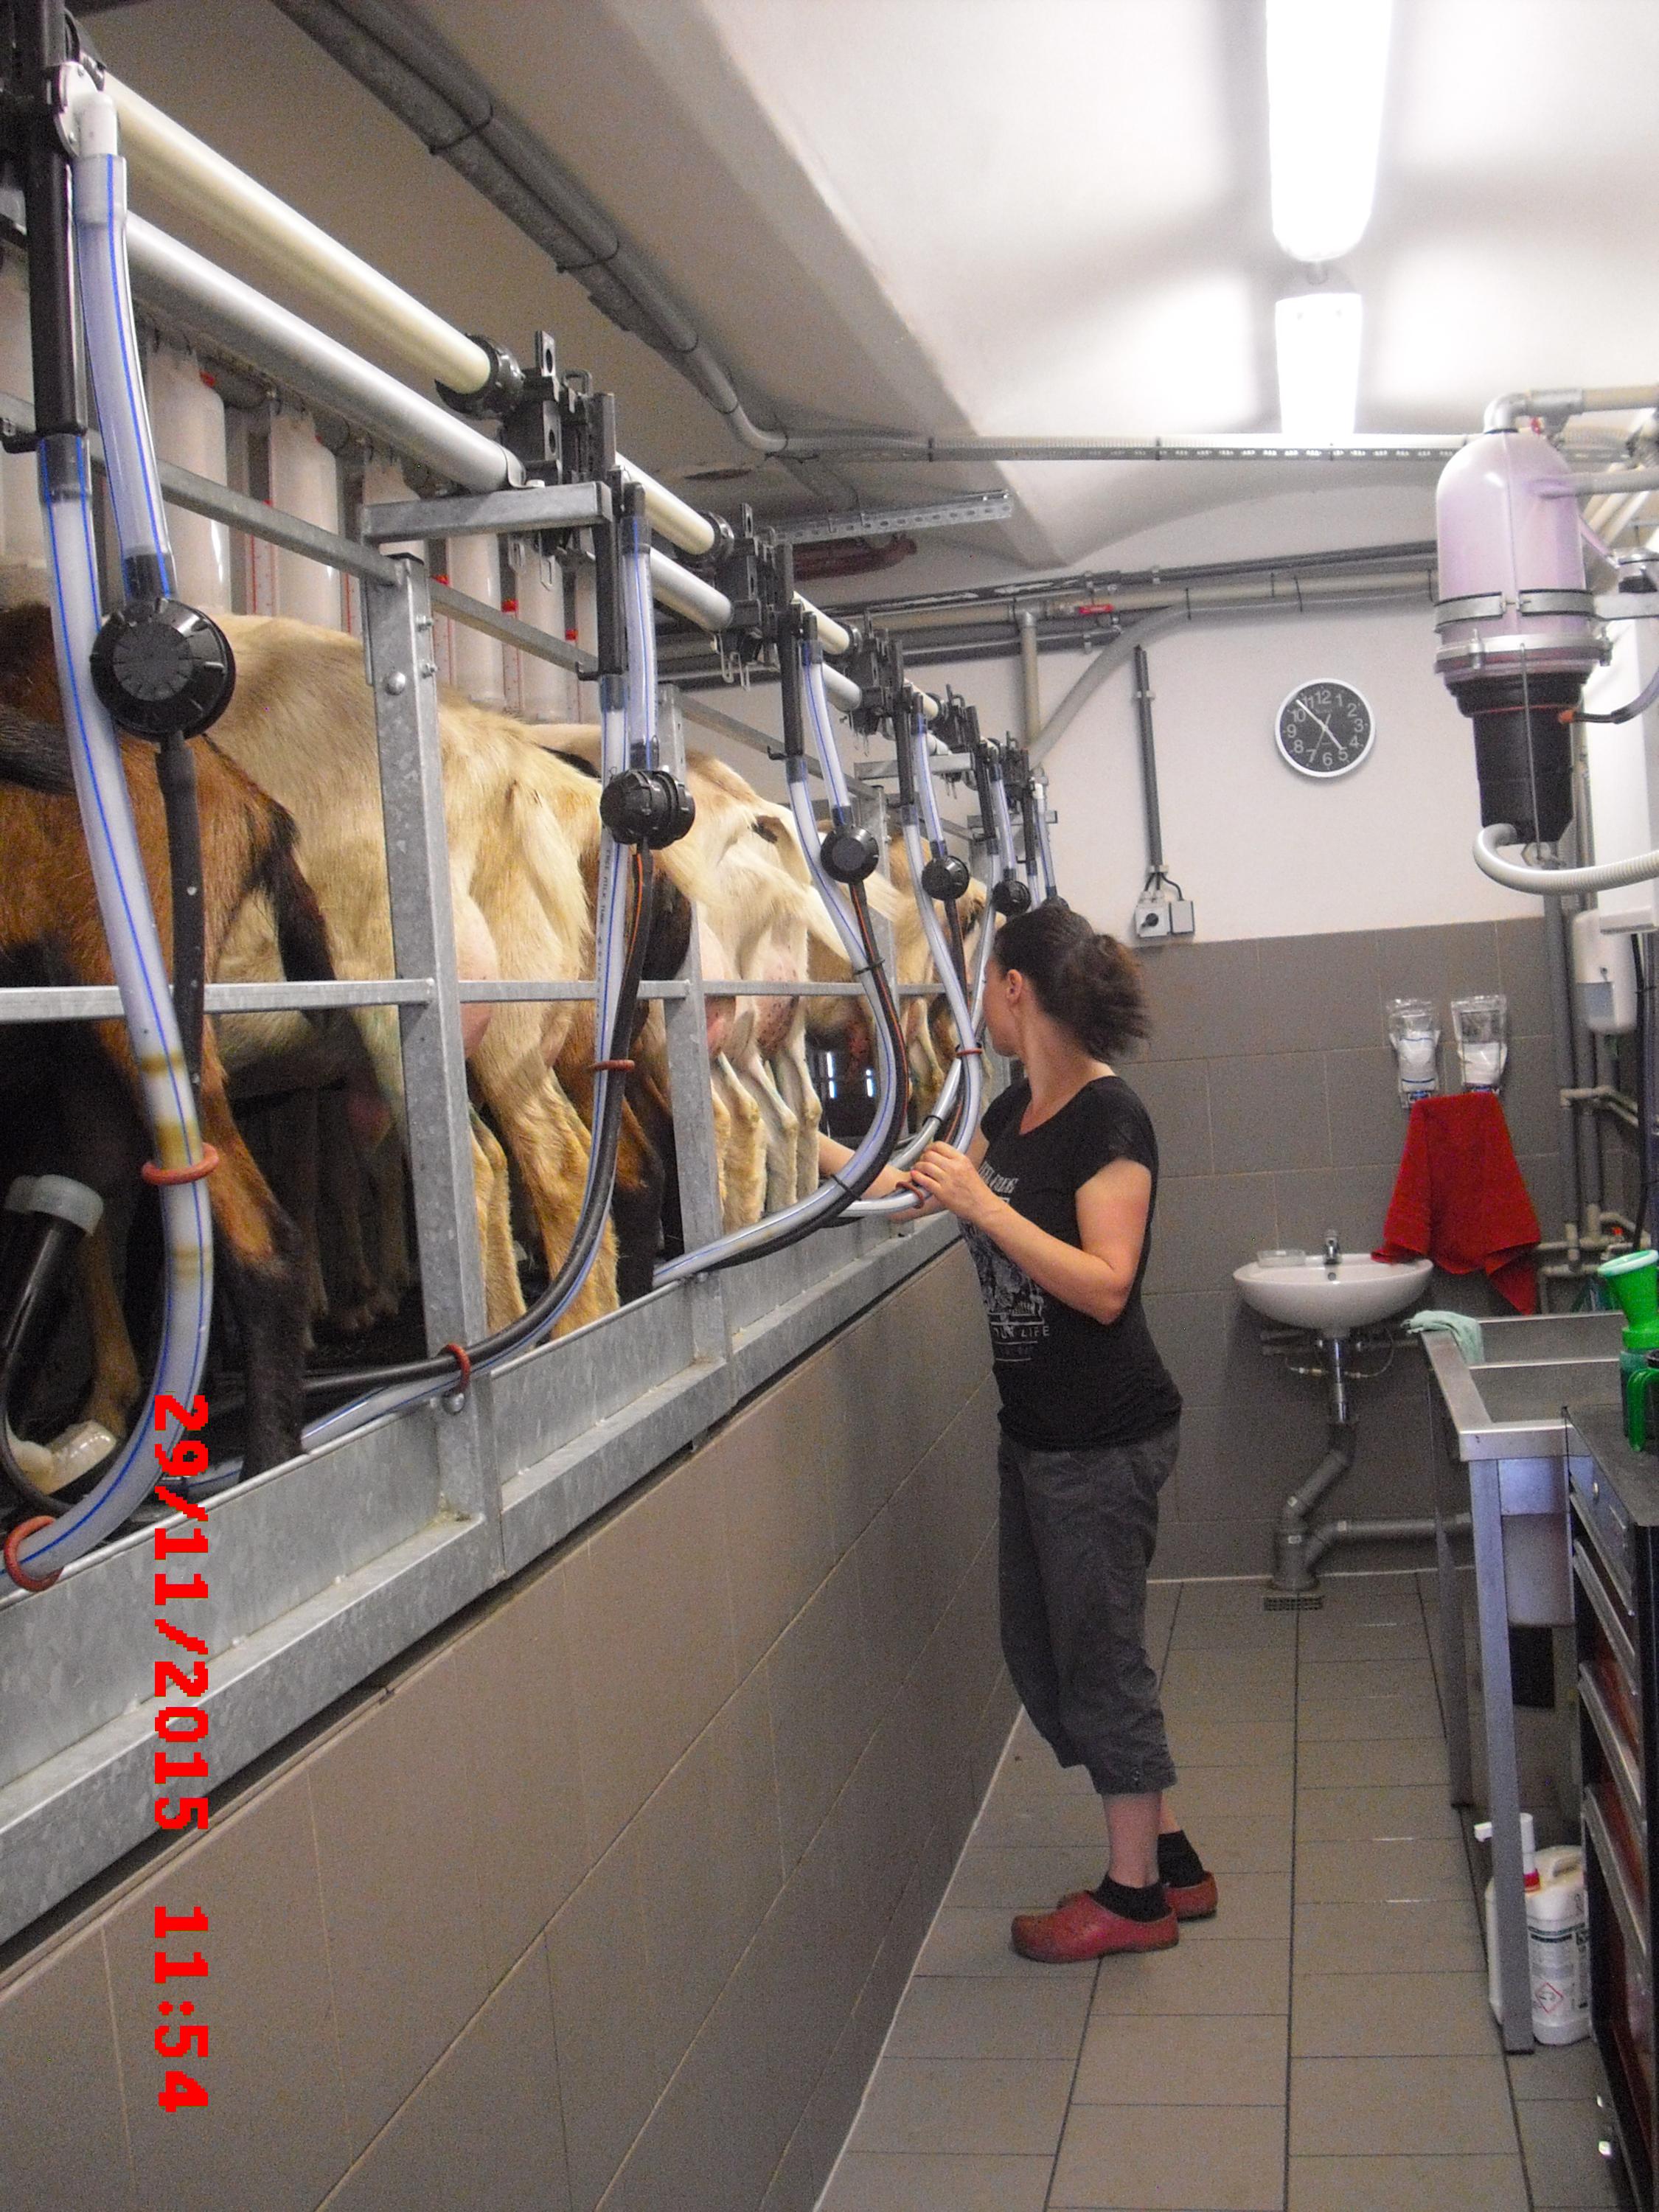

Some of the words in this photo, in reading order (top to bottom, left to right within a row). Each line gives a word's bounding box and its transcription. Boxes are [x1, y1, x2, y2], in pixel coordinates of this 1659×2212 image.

[1303, 696, 1314, 709] 11
[1315, 690, 1331, 704] 12
[1336, 694, 1343, 707] 1
[1291, 709, 1306, 723] 10
[1347, 703, 1357, 717] 2
[1286, 724, 1296, 738] 9
[1354, 718, 1363, 732] 3
[1293, 740, 1304, 754] 8
[1349, 735, 1359, 748] 4
[1306, 749, 1317, 762] 7
[1323, 752, 1333, 766] 6
[1338, 747, 1349, 761] 5
[1021, 1326, 1050, 1338] LIFE
